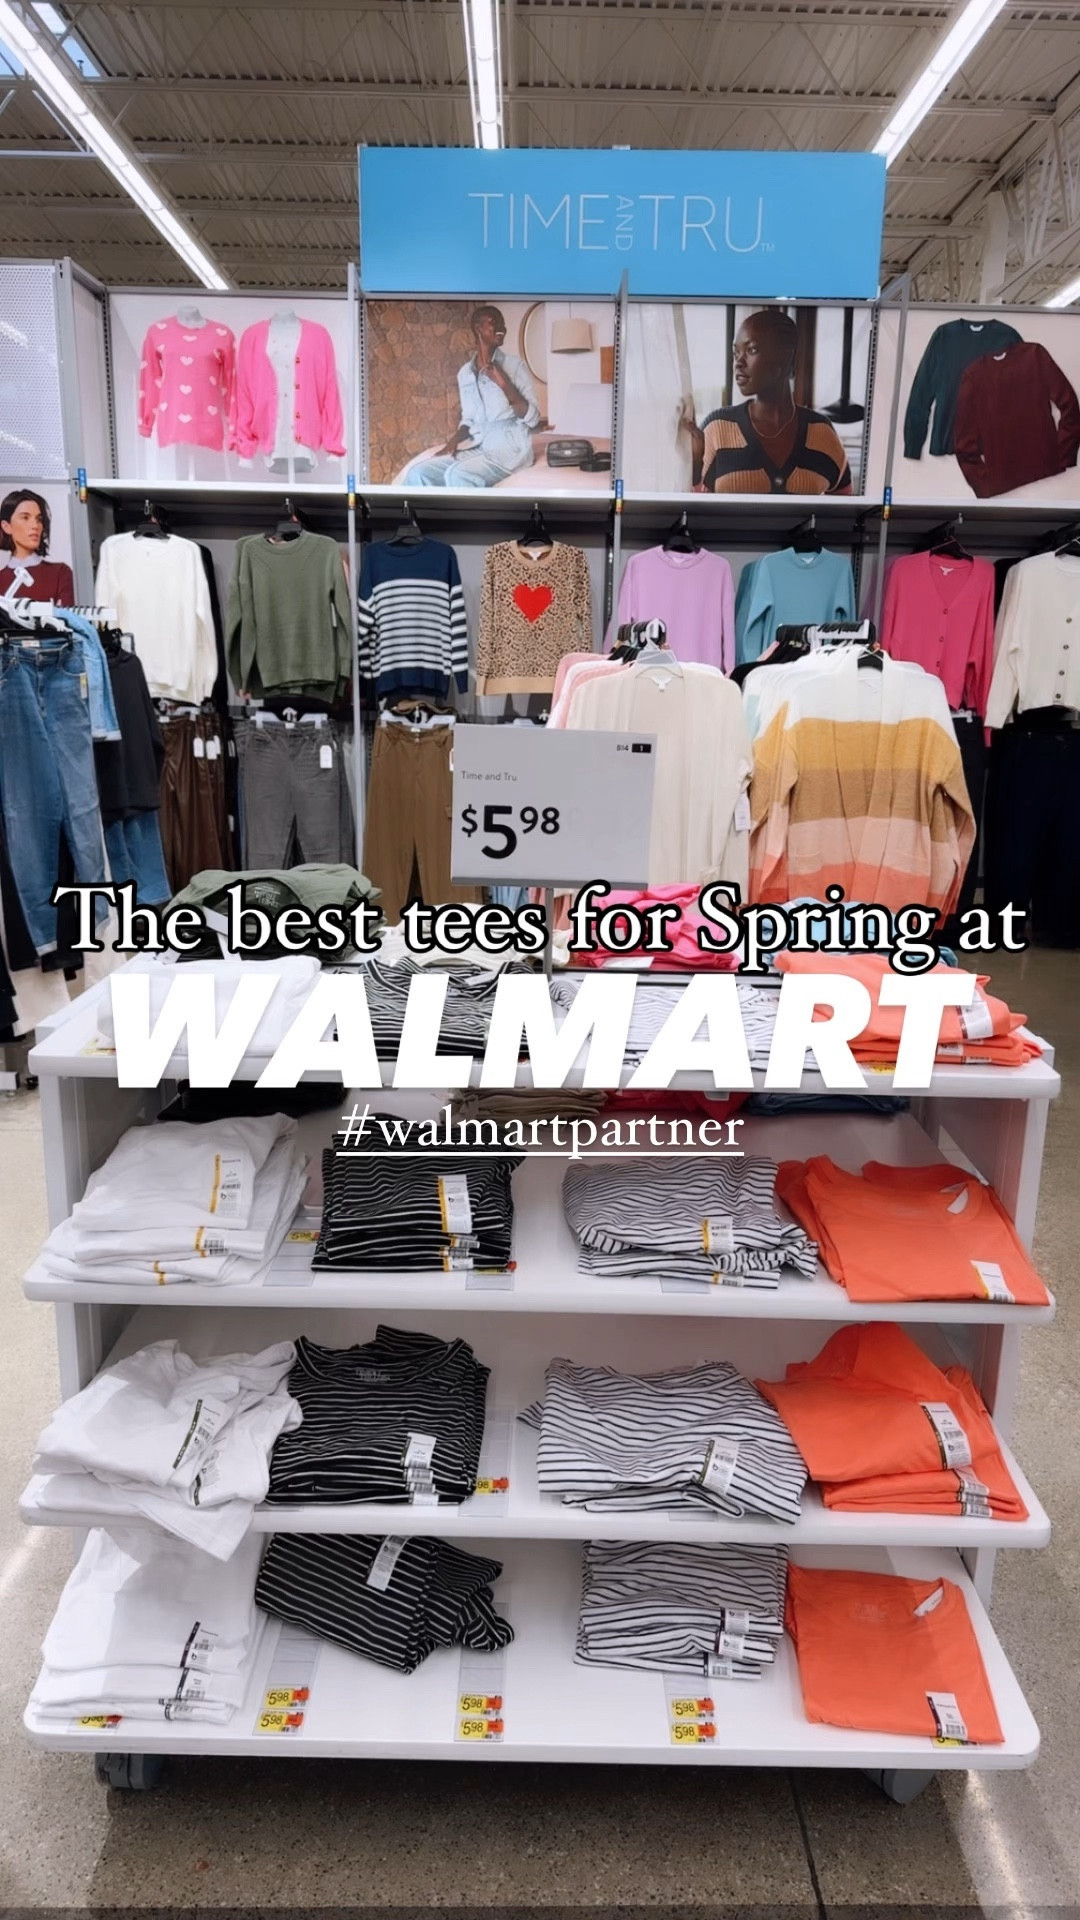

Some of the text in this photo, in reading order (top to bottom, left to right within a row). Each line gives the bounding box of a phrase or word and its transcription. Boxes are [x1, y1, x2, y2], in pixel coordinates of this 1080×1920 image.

[468, 192, 609, 250] TIME
[615, 194, 635, 251] AND
[639, 195, 764, 253] TRU
[461, 770, 518, 781] Time and Tru
